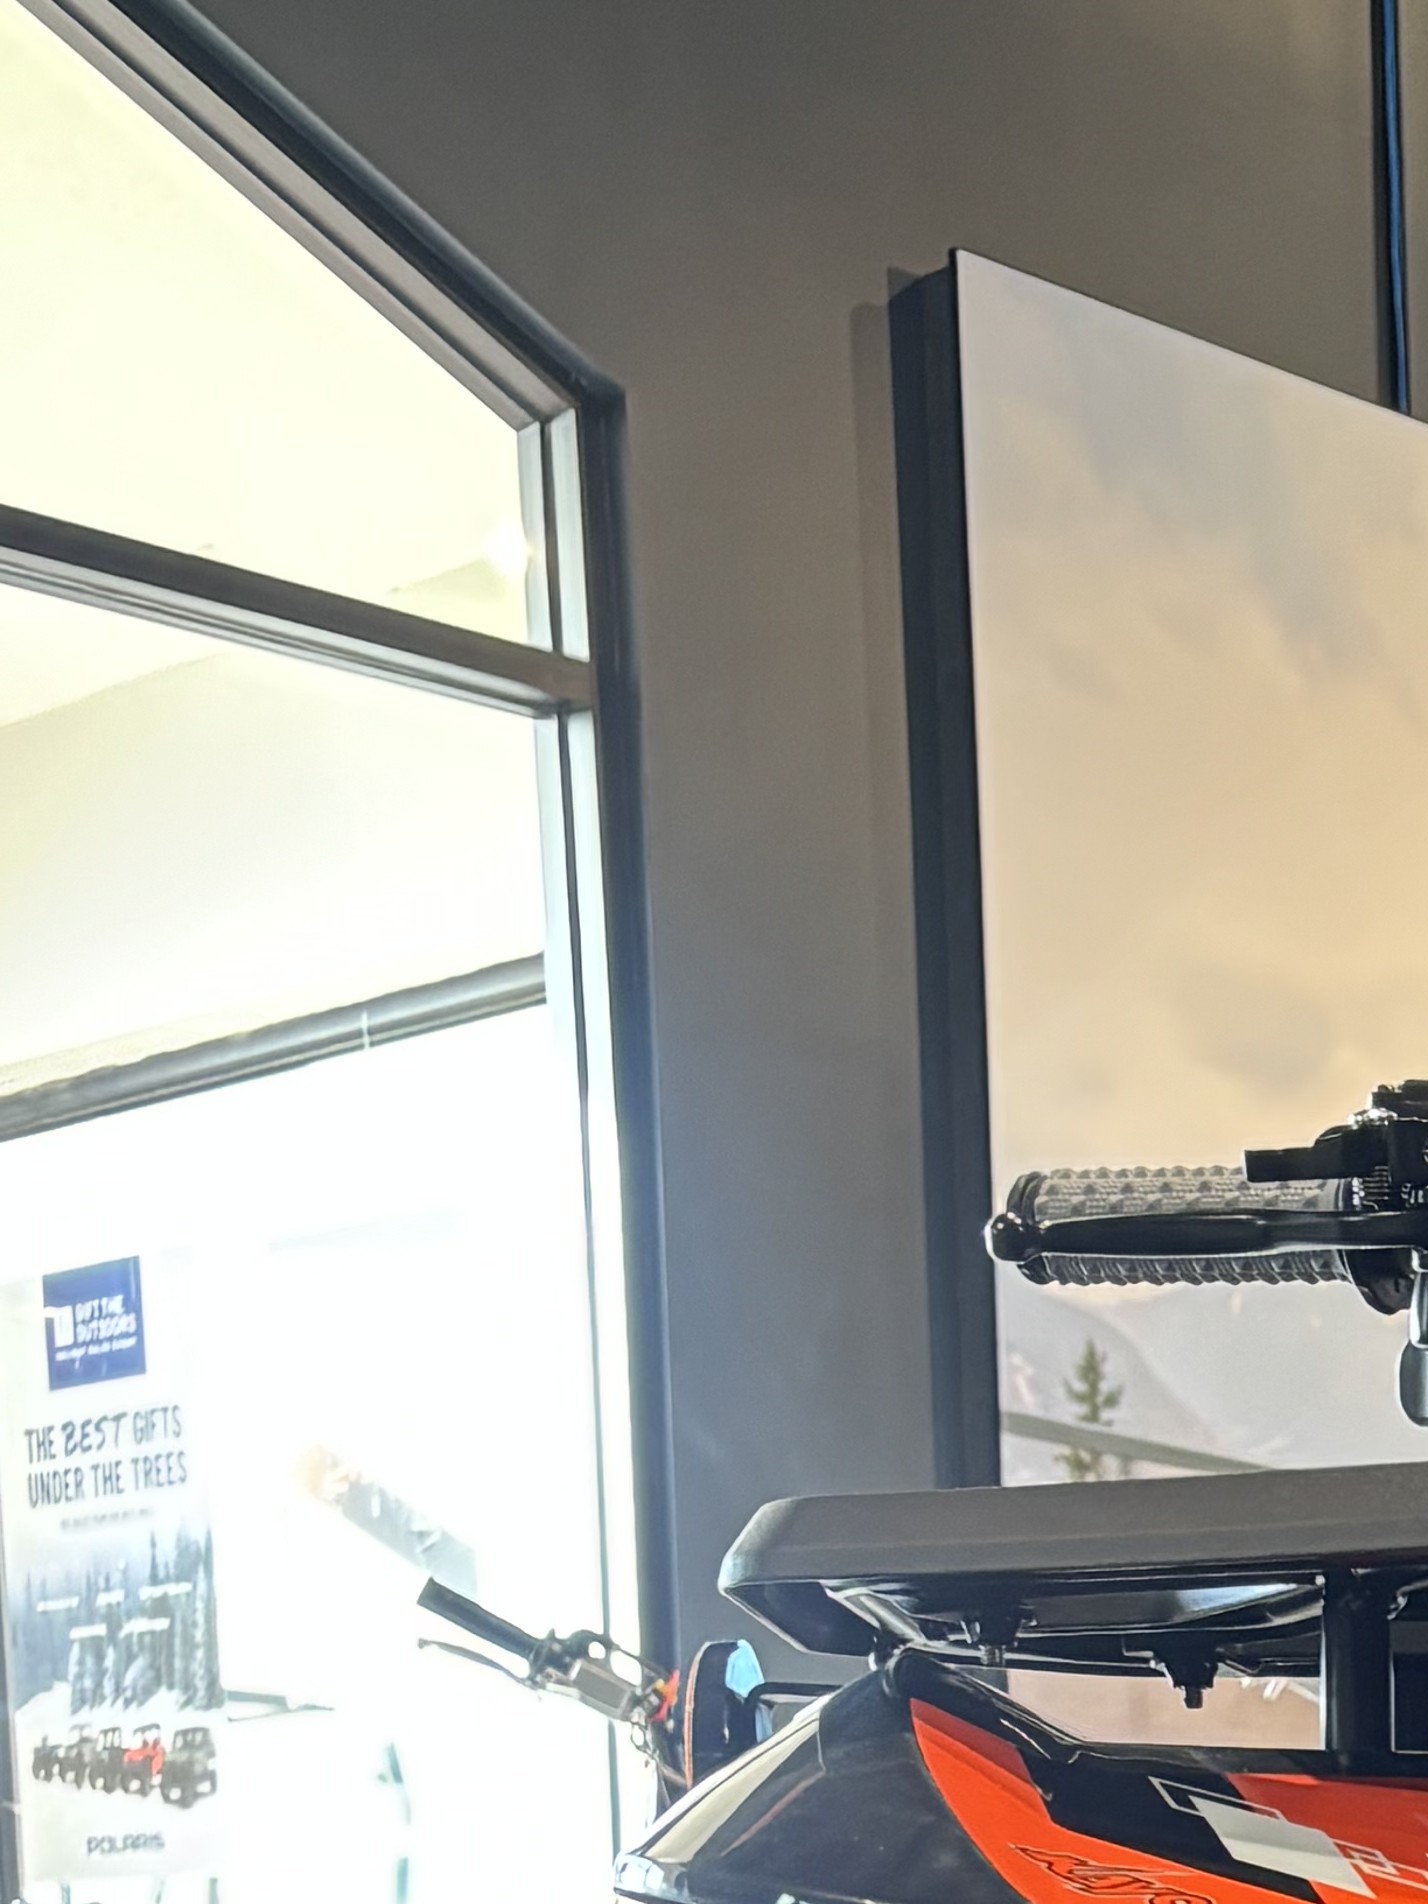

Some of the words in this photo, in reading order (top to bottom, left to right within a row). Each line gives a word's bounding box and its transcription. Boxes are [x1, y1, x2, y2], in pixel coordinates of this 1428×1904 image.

[24, 1425, 57, 1464] THE
[61, 1411, 129, 1457] BEST
[132, 1404, 182, 1445] GIFTS
[27, 1465, 86, 1509] UNDER
[91, 1459, 125, 1499] THE
[131, 1450, 188, 1492] TREES
[86, 1832, 165, 1857] POLARIS
